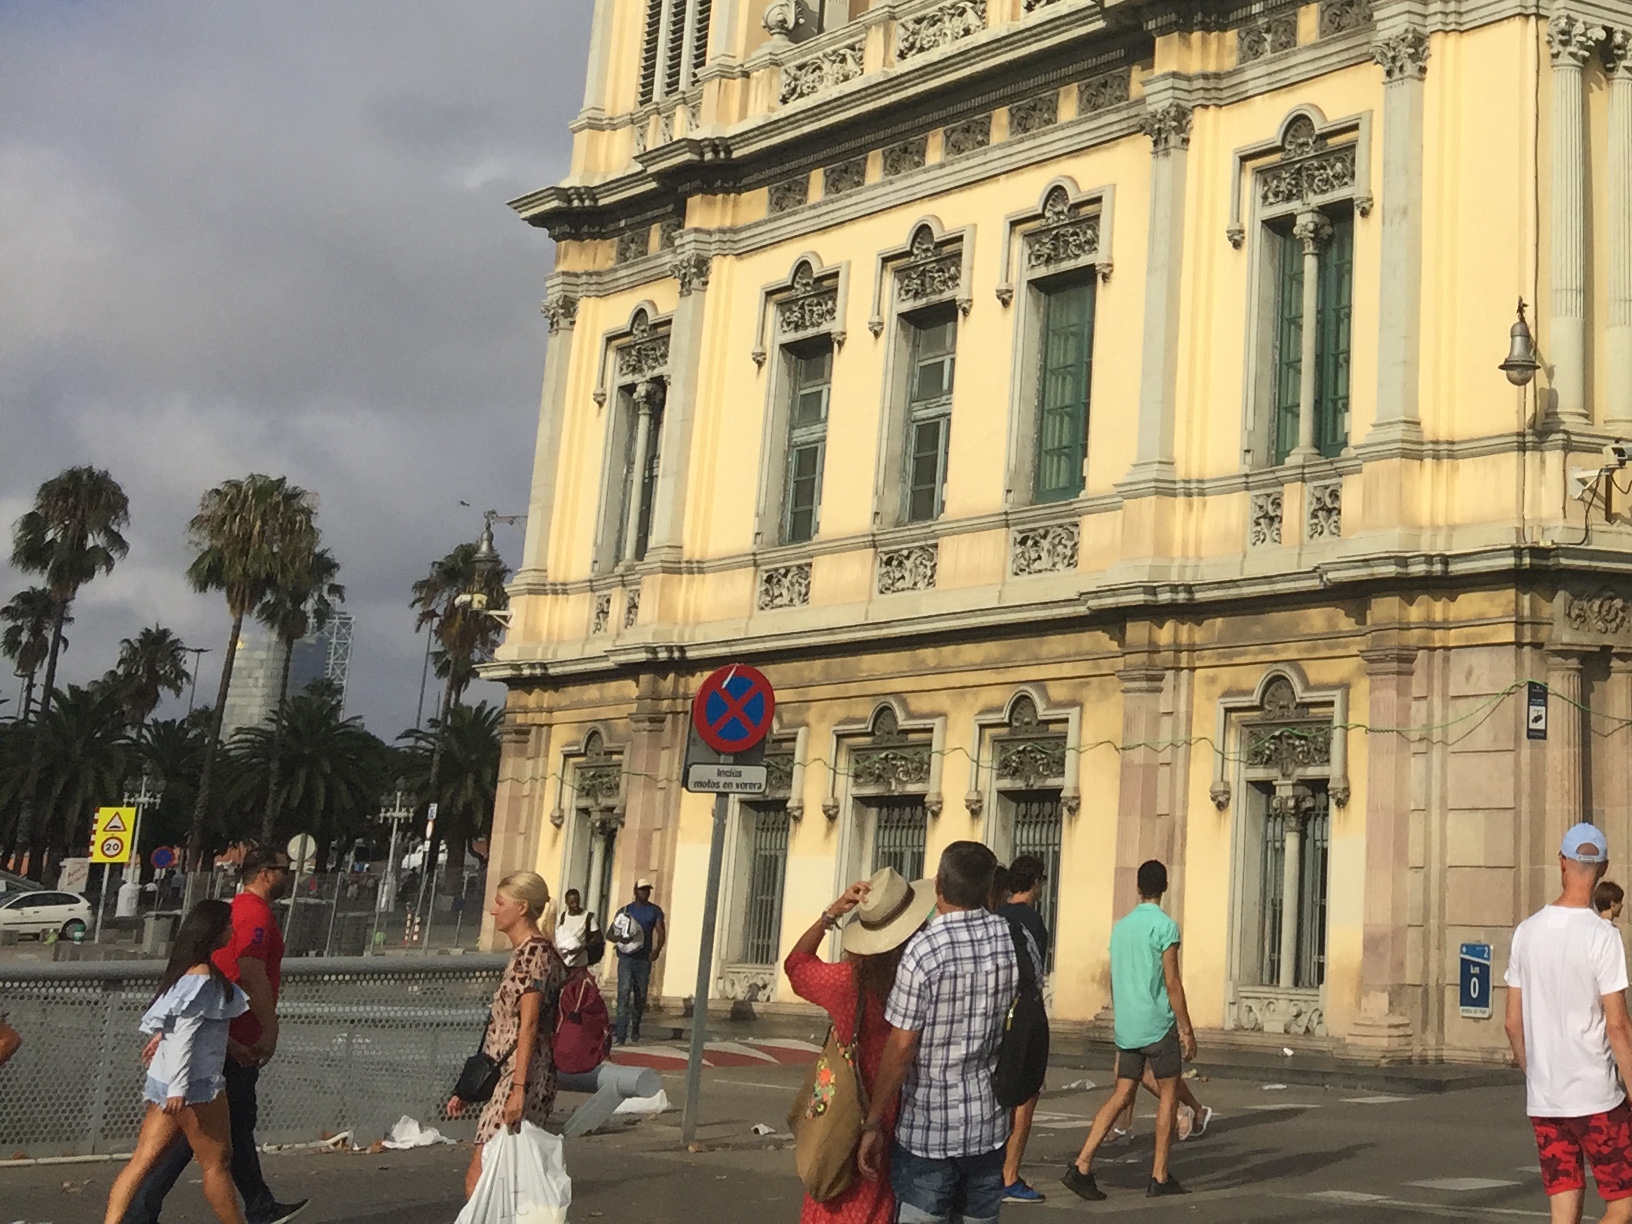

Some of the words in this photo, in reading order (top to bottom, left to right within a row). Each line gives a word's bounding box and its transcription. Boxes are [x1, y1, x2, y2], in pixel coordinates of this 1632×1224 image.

[693, 779, 720, 788] motos
[722, 781, 733, 789] en
[736, 781, 762, 790] vorera
[105, 843, 120, 851] 20
[1483, 947, 1489, 958] 2
[1470, 964, 1480, 974] km
[1470, 977, 1479, 998] 0
